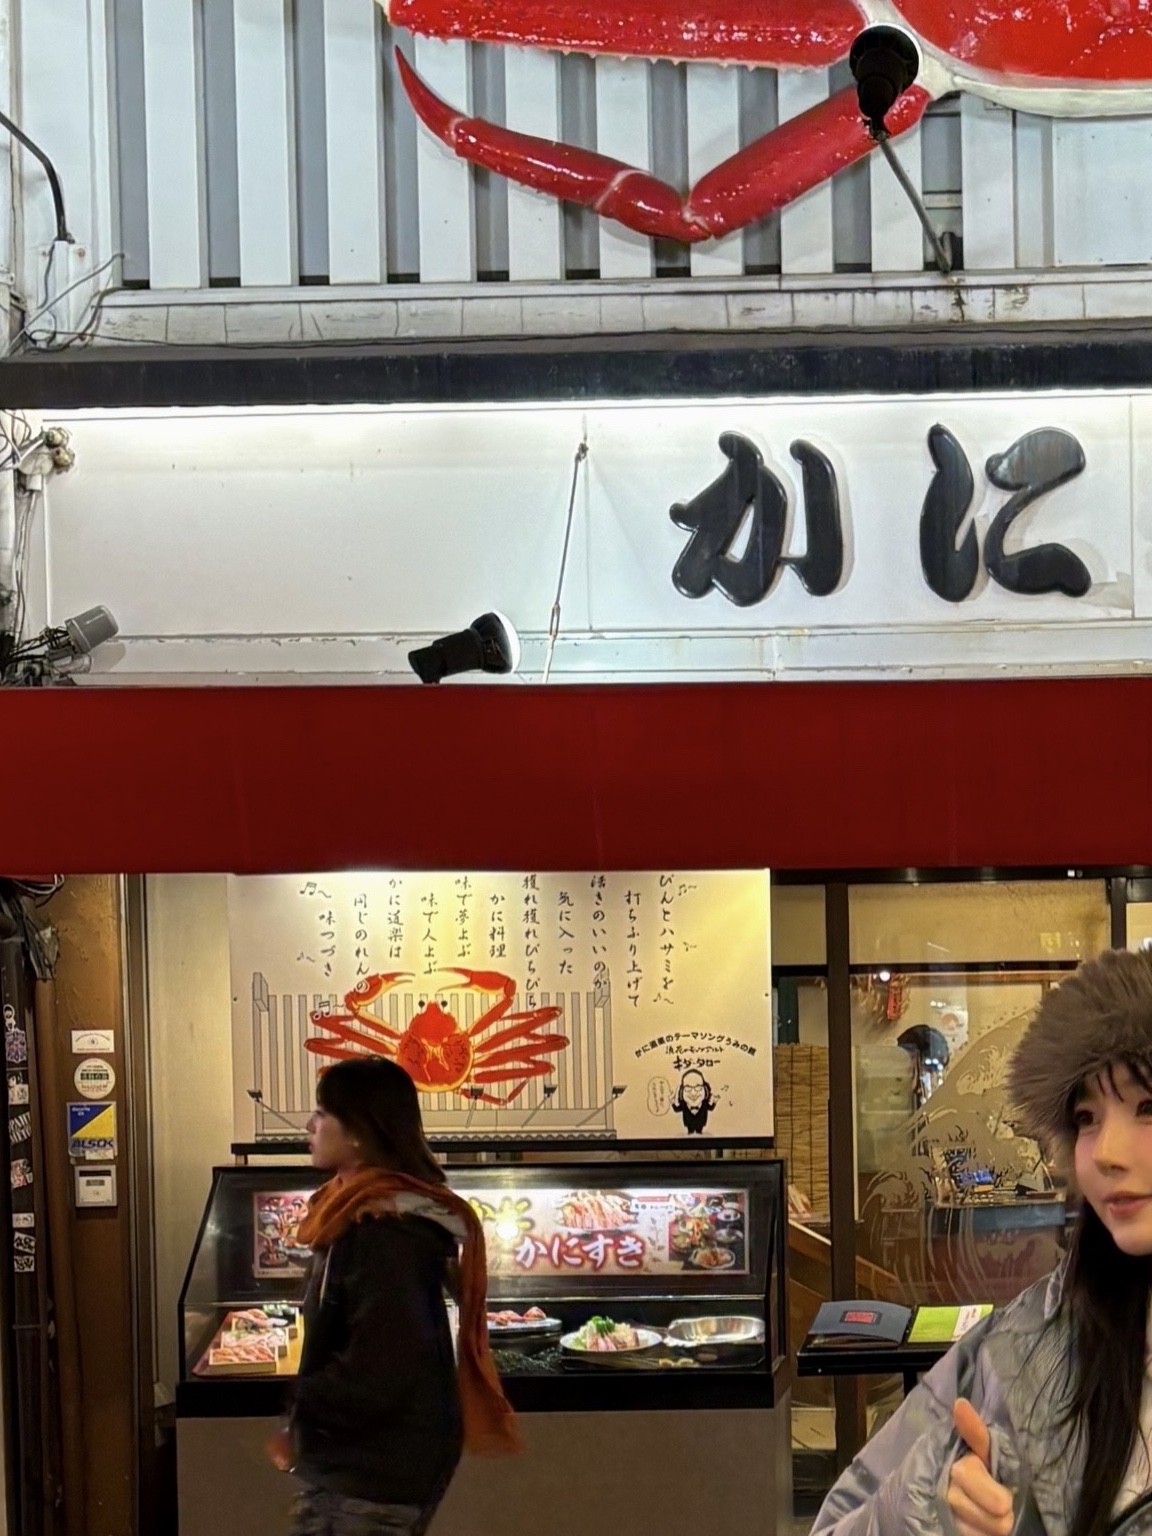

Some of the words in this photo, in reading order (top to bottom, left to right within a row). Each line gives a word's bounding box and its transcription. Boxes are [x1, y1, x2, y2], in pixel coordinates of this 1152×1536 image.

[318, 910, 336, 977] 味つづき
[420, 892, 439, 975] 味で人よぶ
[454, 876, 472, 958] 味で夢よぶ
[488, 893, 507, 958] かに料理
[557, 891, 575, 974] 気に入った
[71, 1139, 114, 1149] ALSOK
[514, 1235, 643, 1269] かにすき
